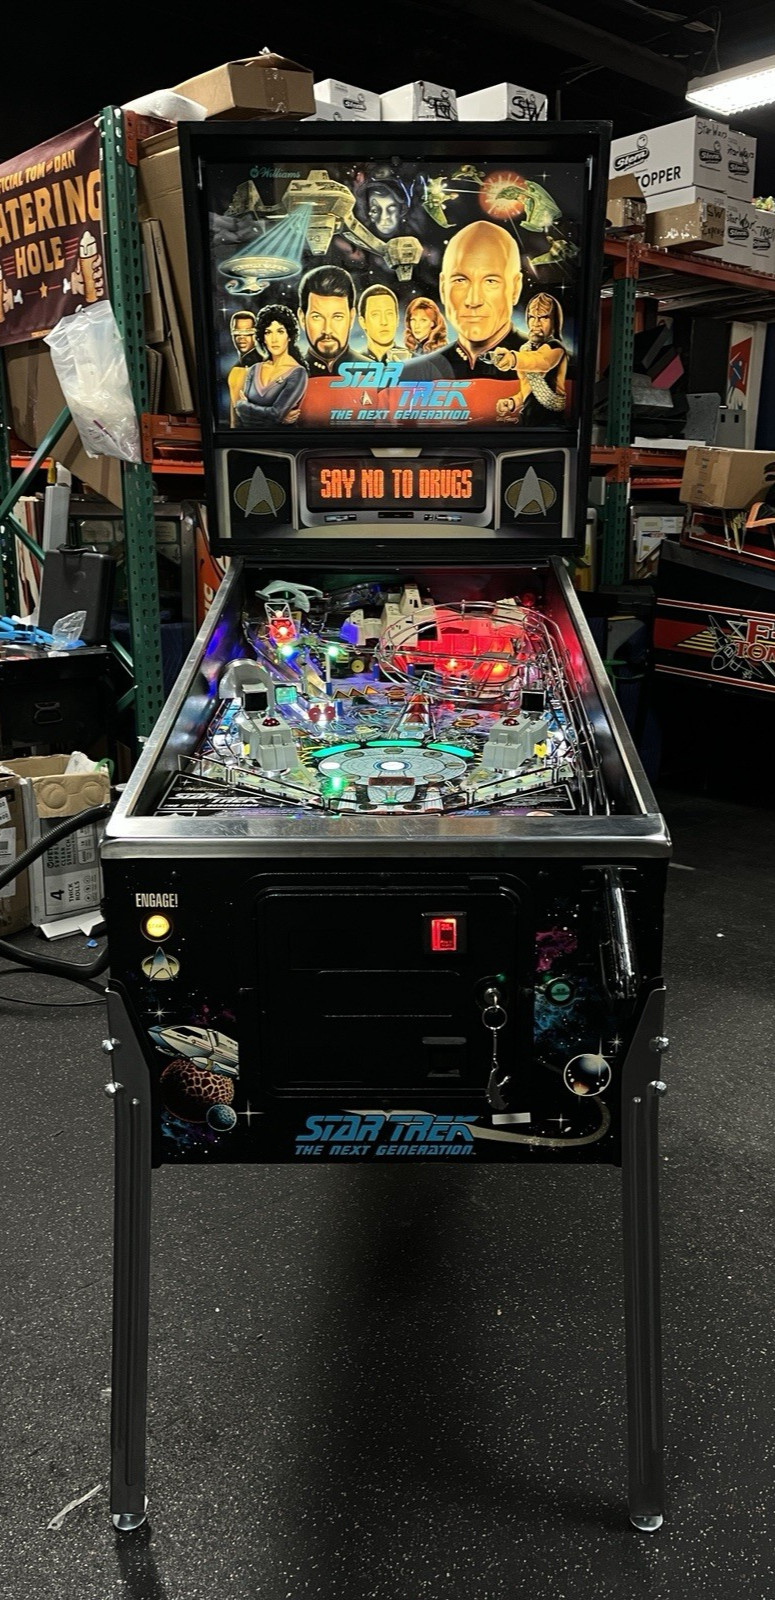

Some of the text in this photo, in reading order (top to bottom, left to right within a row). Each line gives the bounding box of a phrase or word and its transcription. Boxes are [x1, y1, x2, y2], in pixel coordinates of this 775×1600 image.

[615, 148, 649, 170] Stern
[0, 149, 76, 194] ICIAL TOM DAN
[258, 166, 301, 179] Williams
[706, 203, 725, 218] SW
[15, 235, 65, 279] HOLE
[329, 362, 404, 388] STAR
[398, 381, 472, 407] TREK
[330, 409, 471, 421] THE NEXT GENERATION
[320, 468, 473, 499] SAY NO TO DRUGS
[50, 889, 65, 900] 4
[135, 893, 178, 908] ENGAGE!
[294, 1114, 480, 1140] STAR TREK
[294, 1144, 474, 1156] THE NEXT GENERATION
